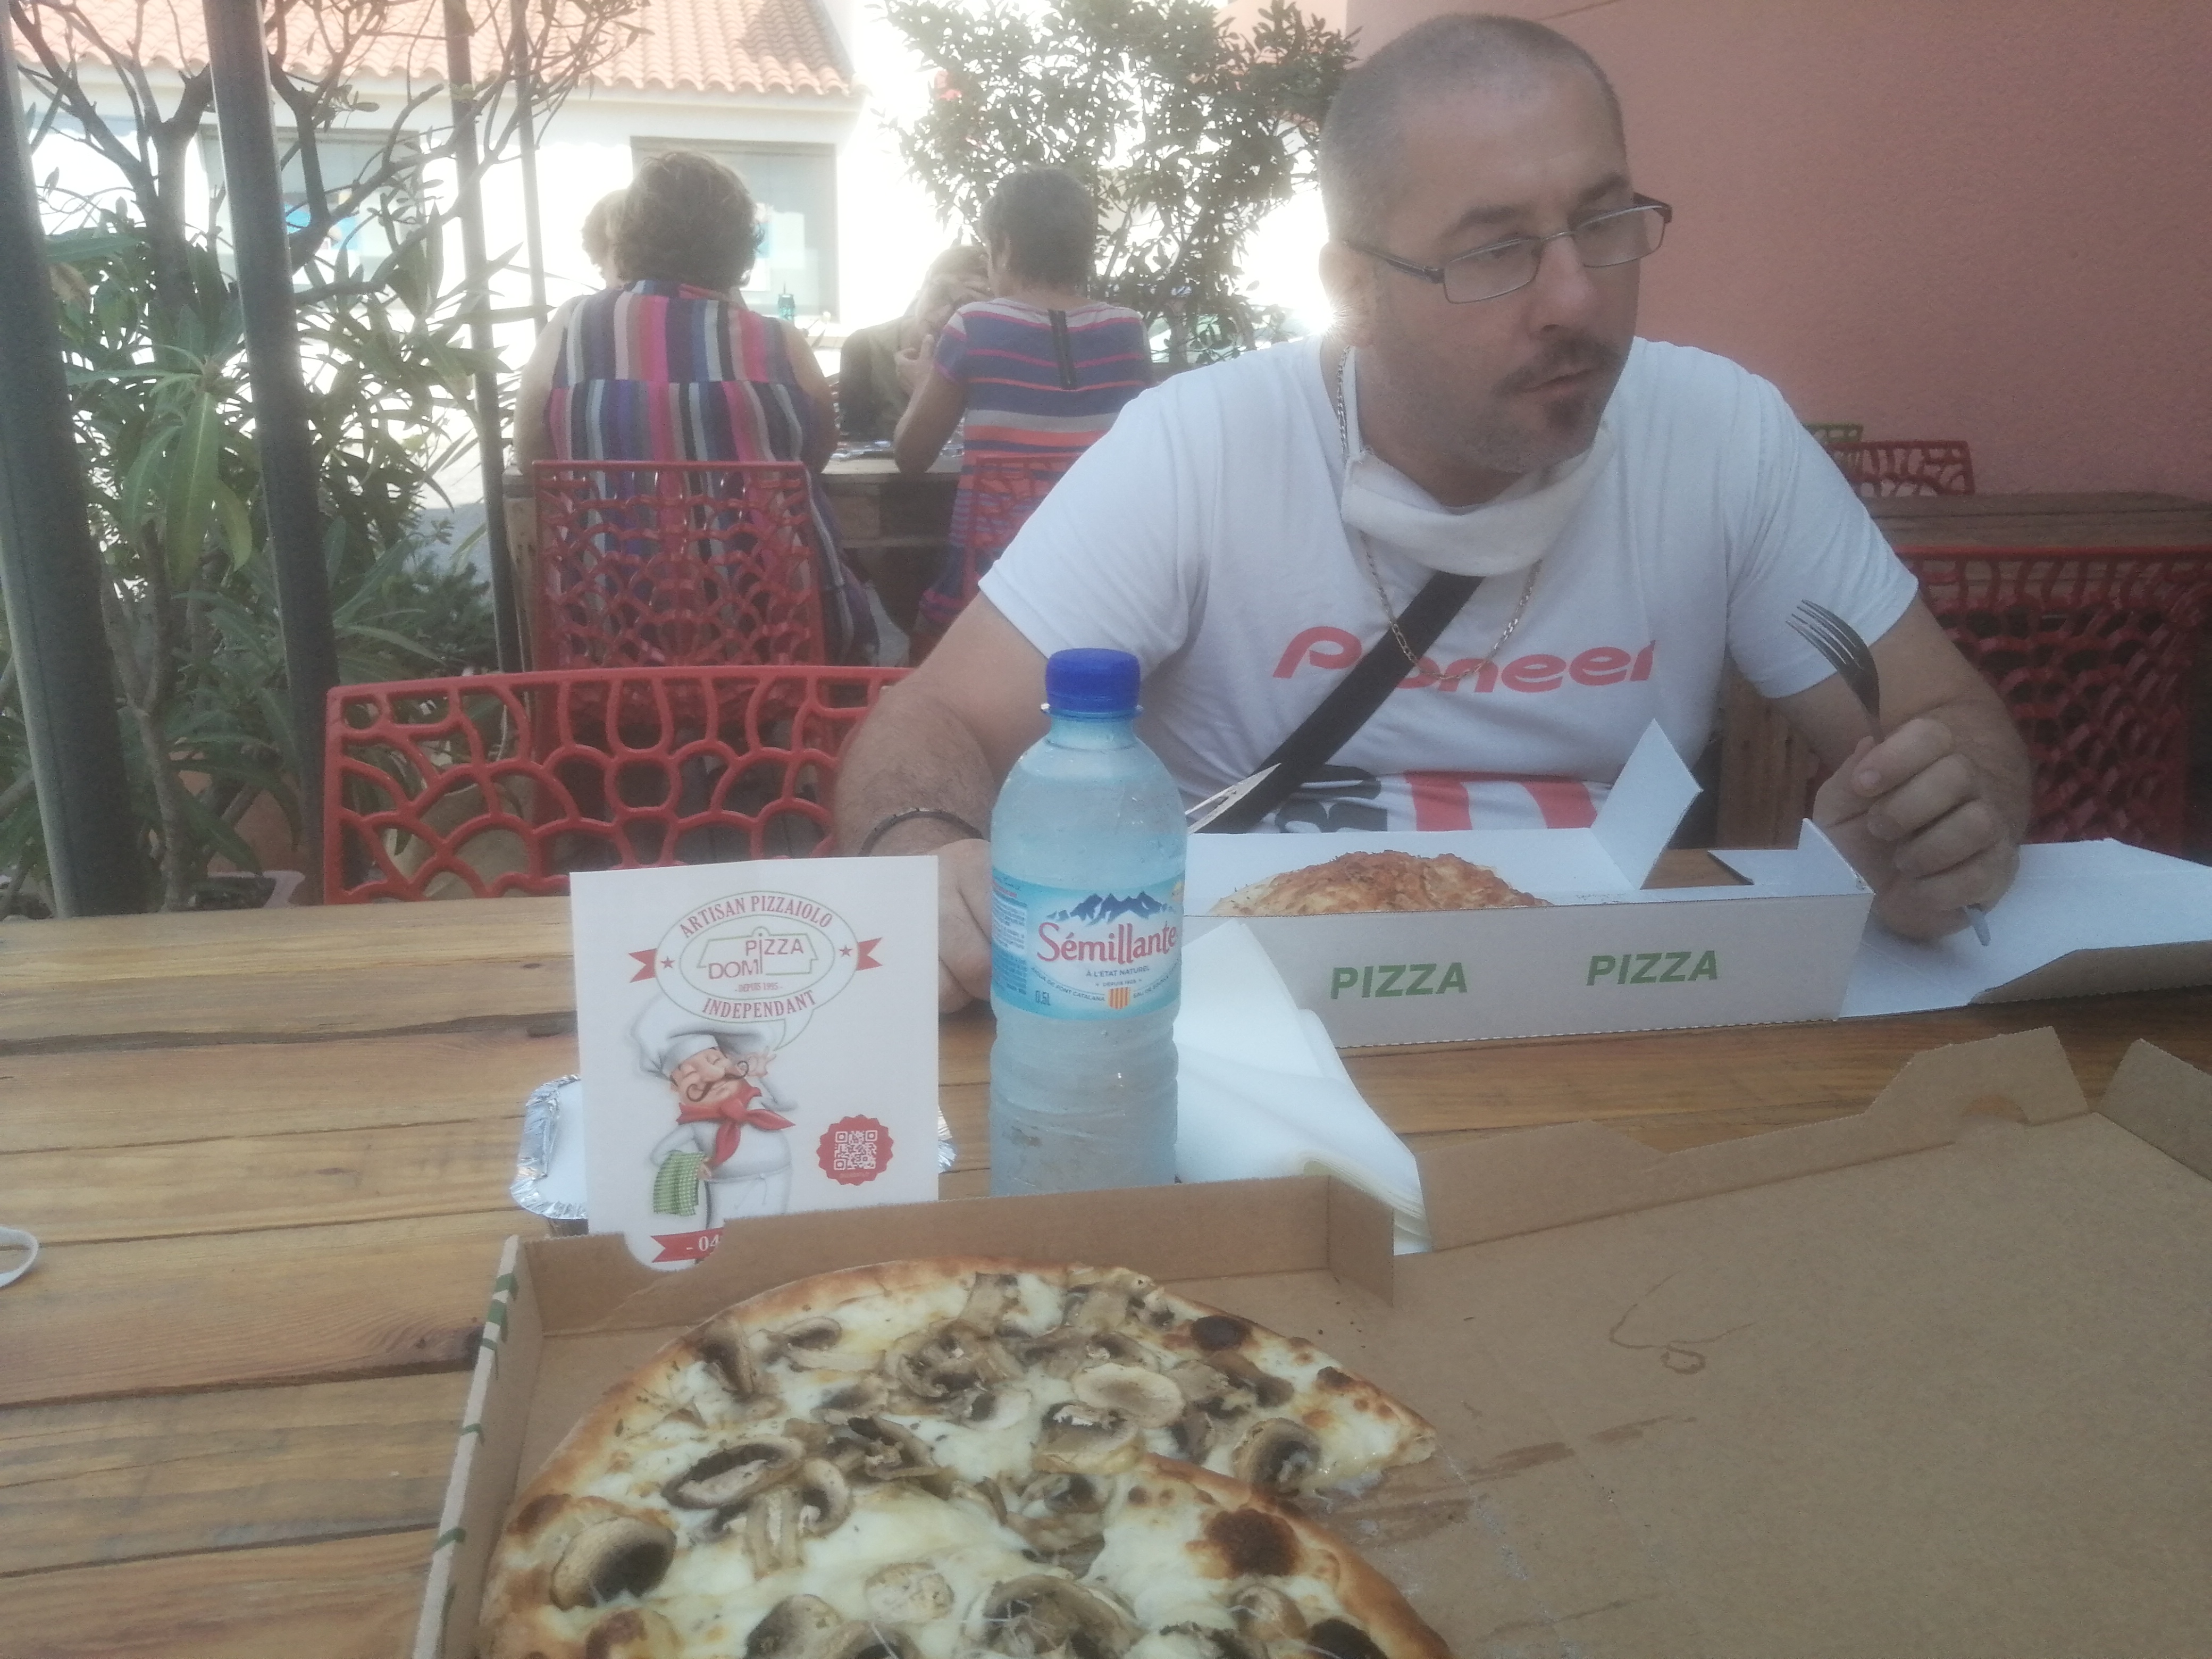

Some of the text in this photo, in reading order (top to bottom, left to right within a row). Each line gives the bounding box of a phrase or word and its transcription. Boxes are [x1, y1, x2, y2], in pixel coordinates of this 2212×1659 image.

[680, 895, 833, 939] ARTISAN PIZZAIOLO
[745, 937, 804, 956] PIZZA
[1037, 921, 1177, 965] Sémillante
[1330, 962, 1468, 1000] PIZZA
[1586, 950, 1718, 986] PIZZA
[702, 990, 816, 1019] INDEPENDANT
